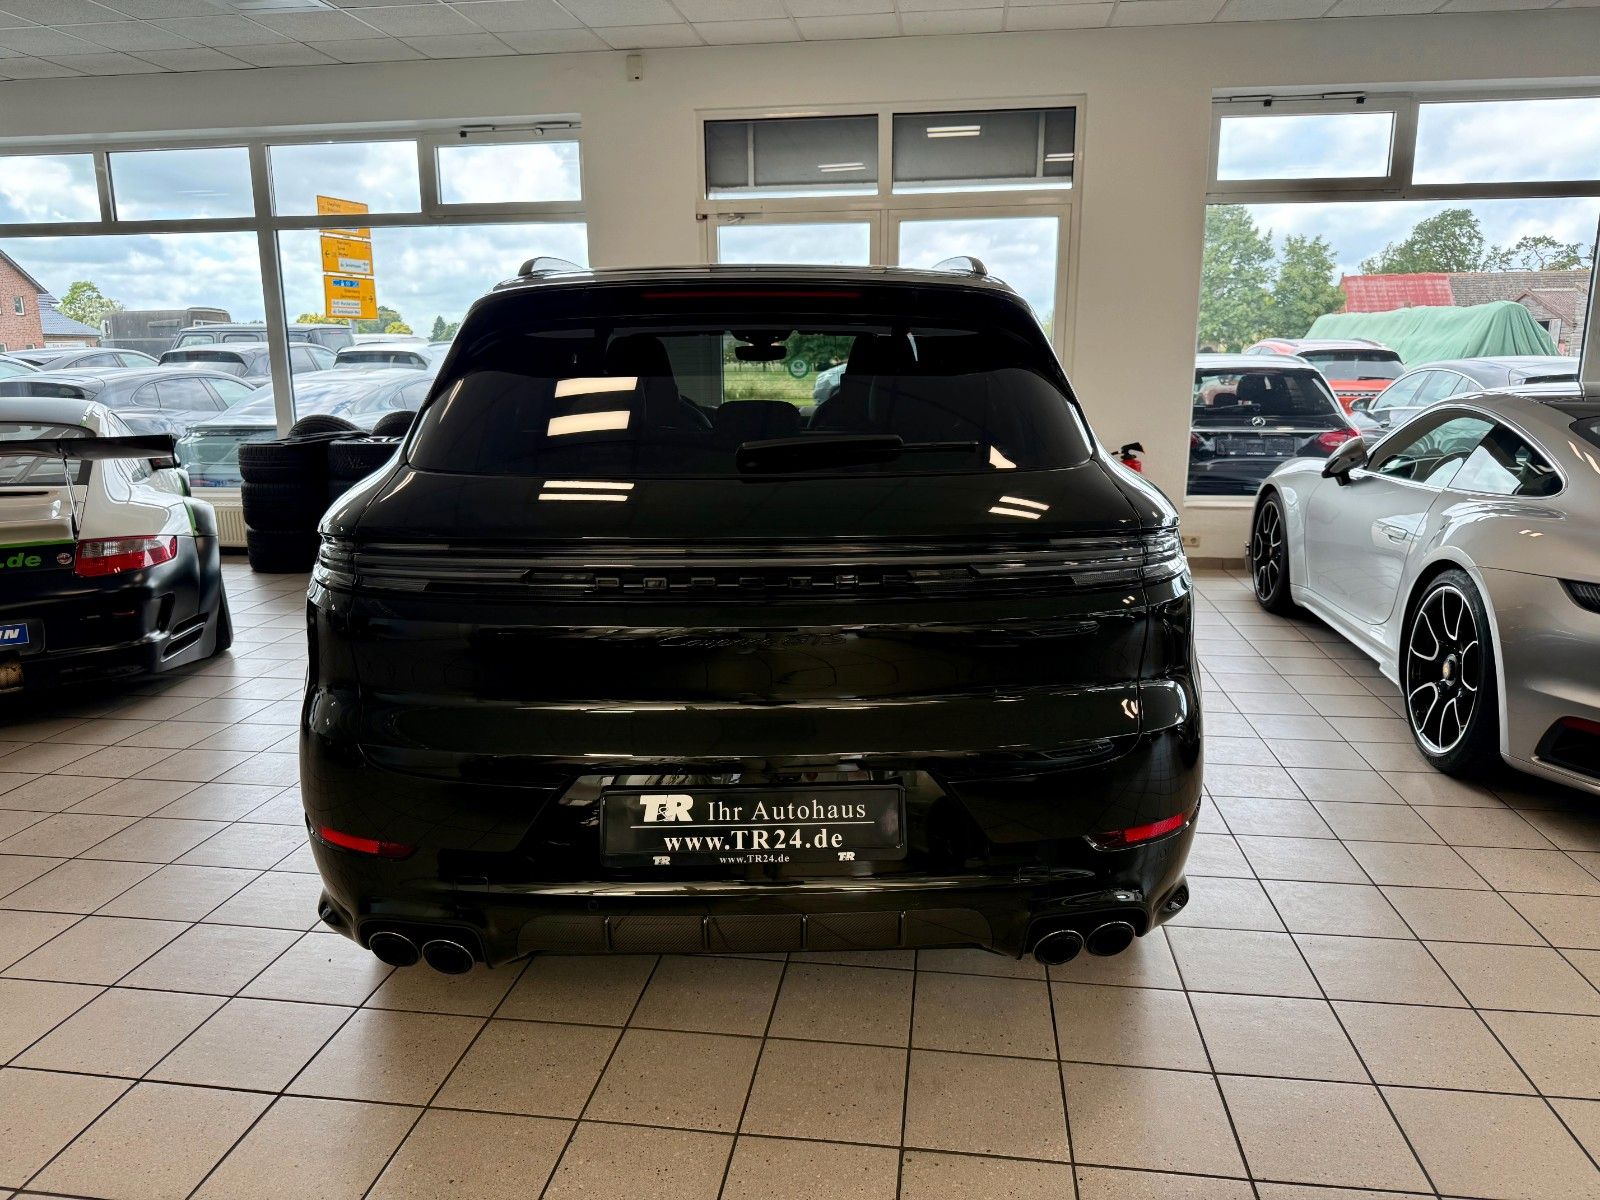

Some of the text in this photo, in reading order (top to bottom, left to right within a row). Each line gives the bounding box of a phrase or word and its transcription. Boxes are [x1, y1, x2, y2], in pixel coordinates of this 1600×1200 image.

[707, 801, 743, 821] Ihr
[751, 799, 866, 821] Autohaus
[664, 828, 843, 852] www.TR24.de
[719, 853, 790, 864] www.TR24.de
